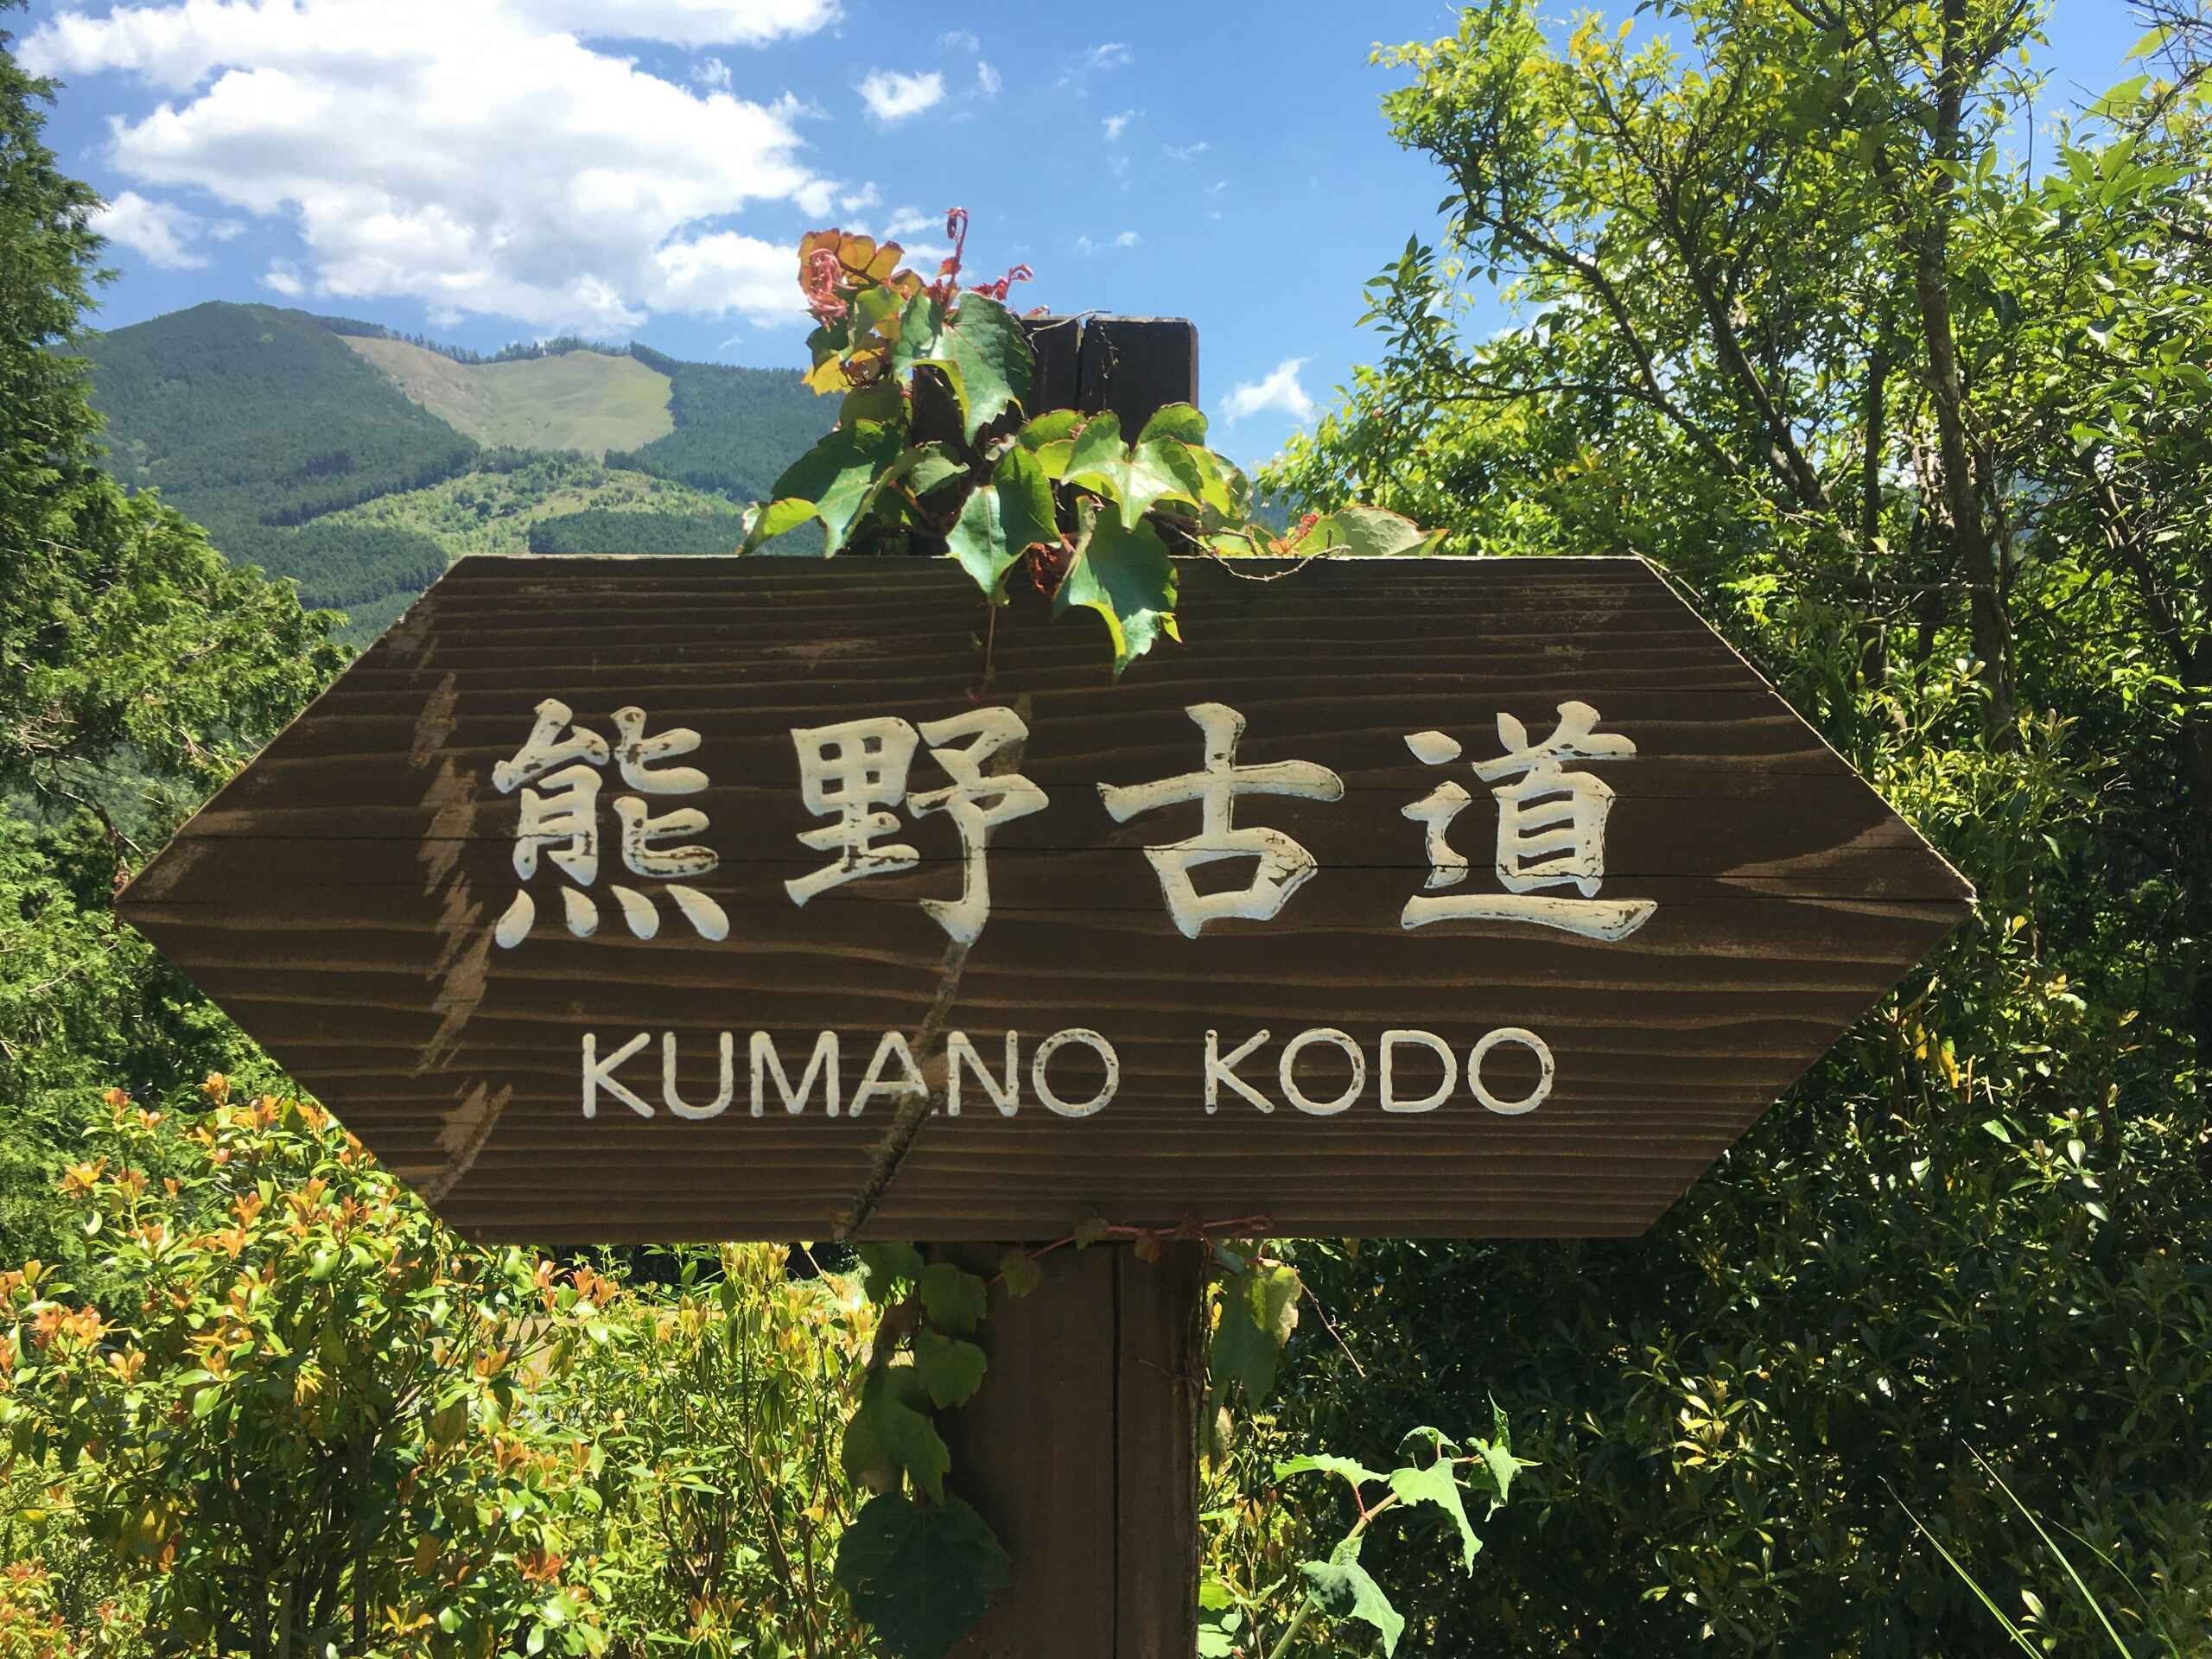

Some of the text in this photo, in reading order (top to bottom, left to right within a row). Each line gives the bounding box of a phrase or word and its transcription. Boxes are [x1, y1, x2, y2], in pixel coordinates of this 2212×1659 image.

[491, 697, 1658, 949] 熊野古道
[582, 1027, 1556, 1120] KUMANO KODO
